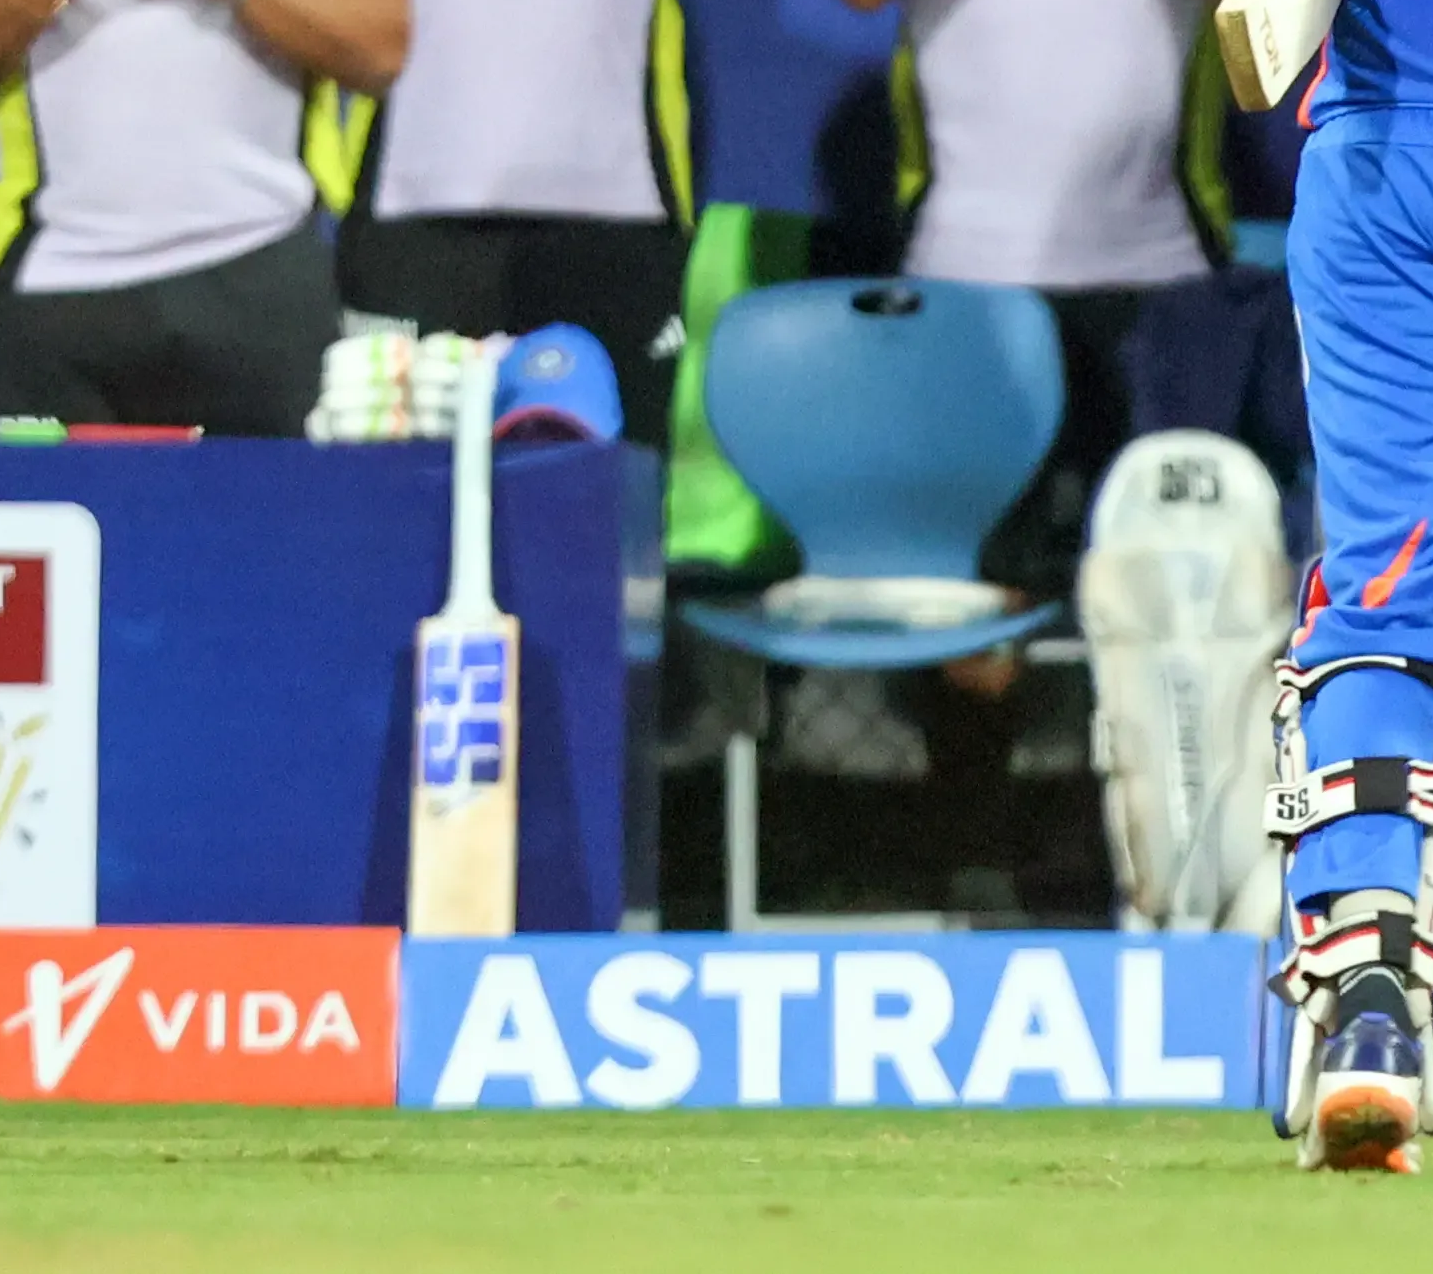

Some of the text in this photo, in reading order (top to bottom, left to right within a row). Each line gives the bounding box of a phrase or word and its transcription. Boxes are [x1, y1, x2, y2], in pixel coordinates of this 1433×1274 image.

[1276, 787, 1310, 820] SS
[139, 989, 363, 1050] VIDA
[433, 951, 1225, 1109] ASTRAL
